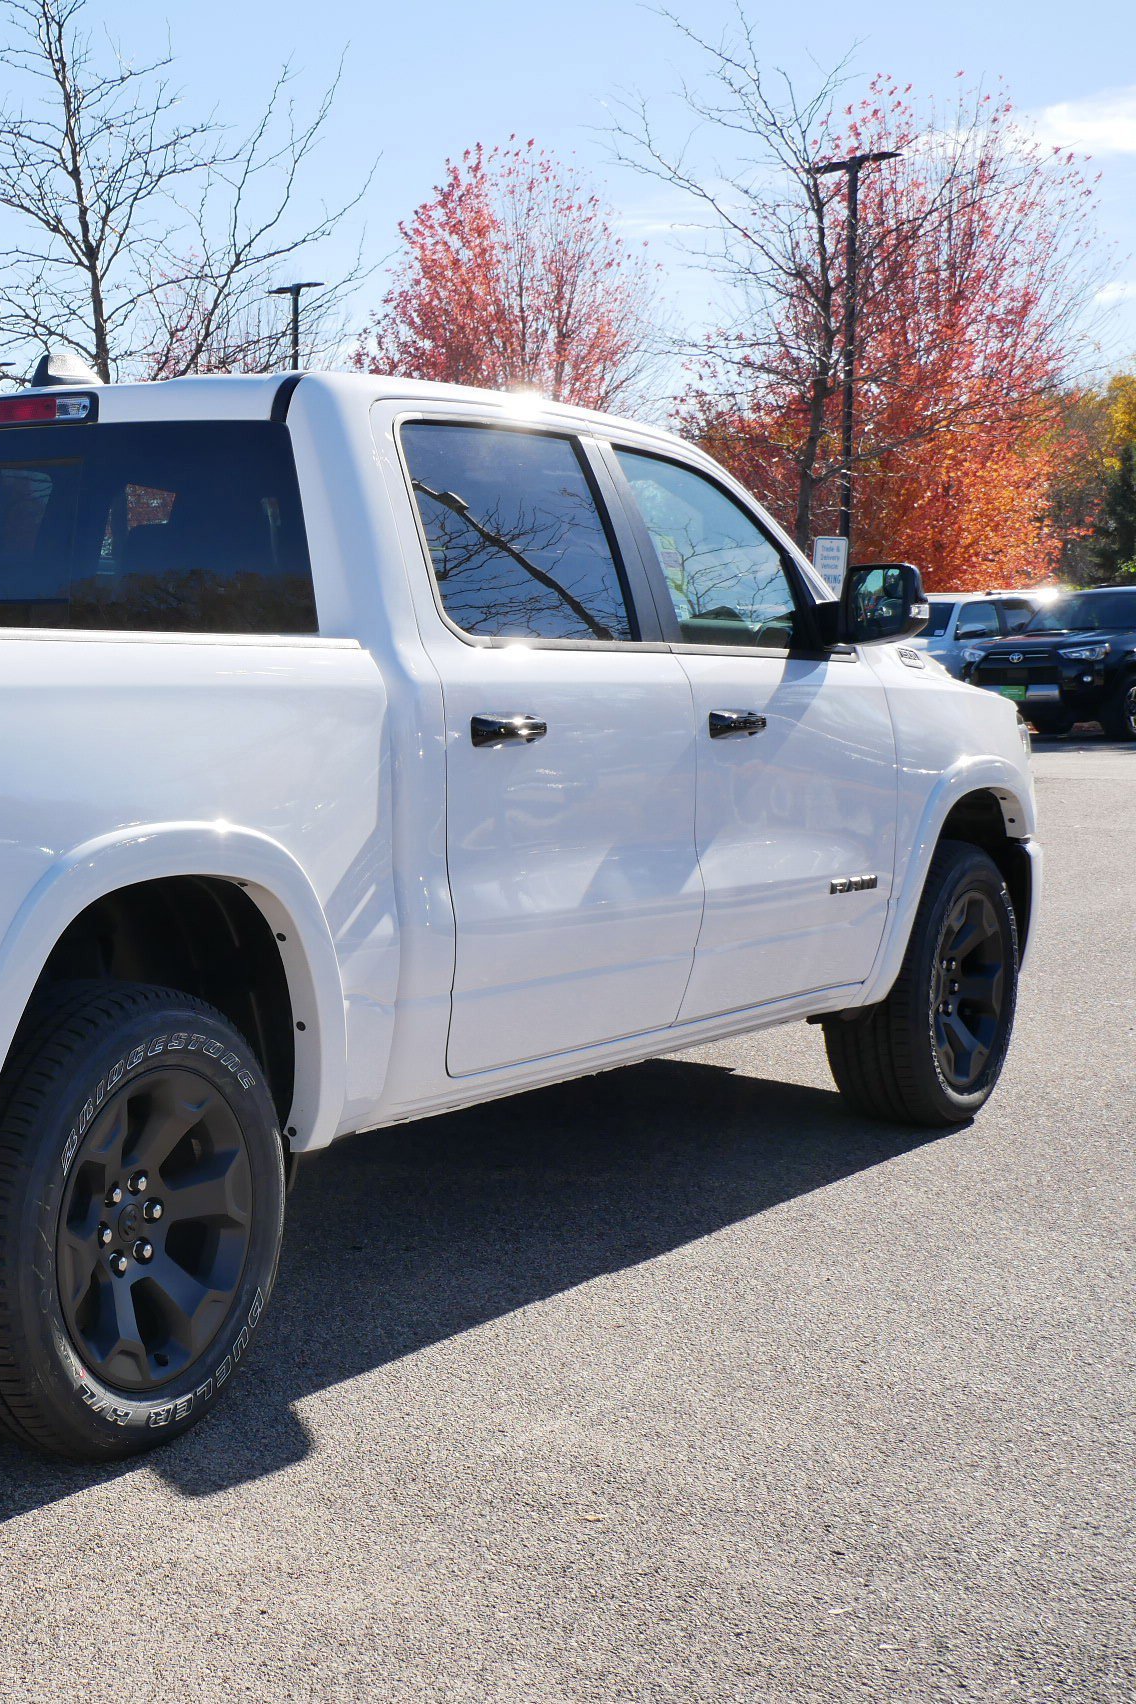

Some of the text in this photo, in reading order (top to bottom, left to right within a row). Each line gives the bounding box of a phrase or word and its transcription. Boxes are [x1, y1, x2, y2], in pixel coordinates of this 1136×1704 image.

[830, 875, 877, 895] RAM
[61, 1033, 256, 1176] BRIDGESTONE
[148, 1287, 264, 1428] DUELER
